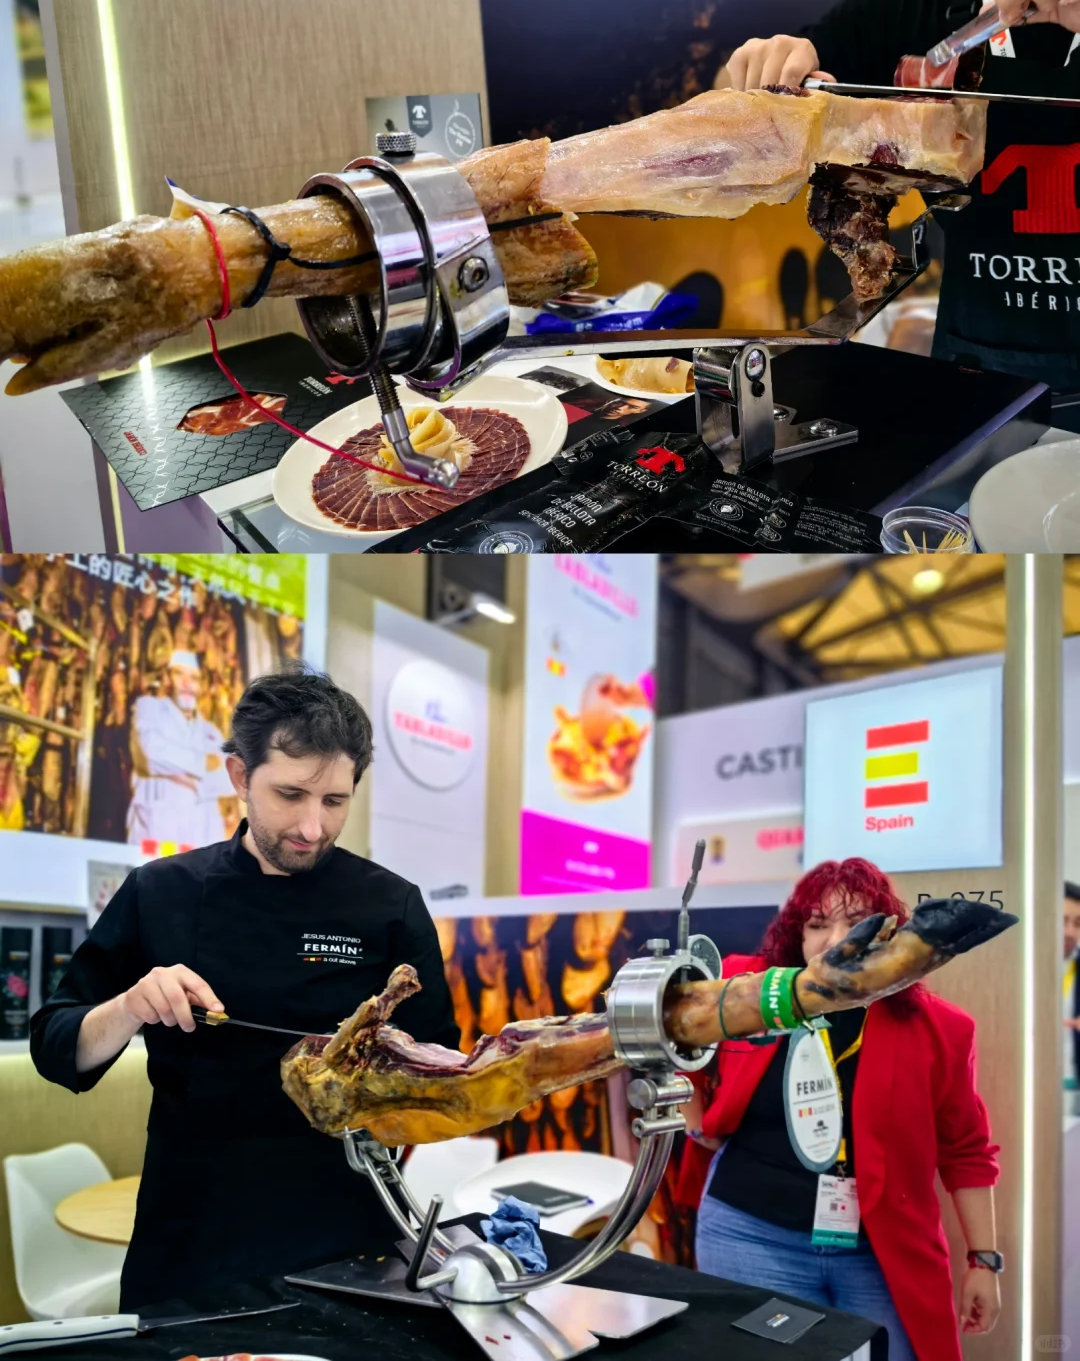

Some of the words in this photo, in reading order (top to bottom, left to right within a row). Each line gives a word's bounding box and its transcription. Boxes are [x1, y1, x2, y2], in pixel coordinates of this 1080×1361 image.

[607, 460, 669, 493] TORREÓN
[570, 493, 603, 513] JAMÓN
[561, 501, 597, 526] BELLOTA
[865, 814, 914, 832] Spain
[326, 934, 361, 944] ANTONIO
